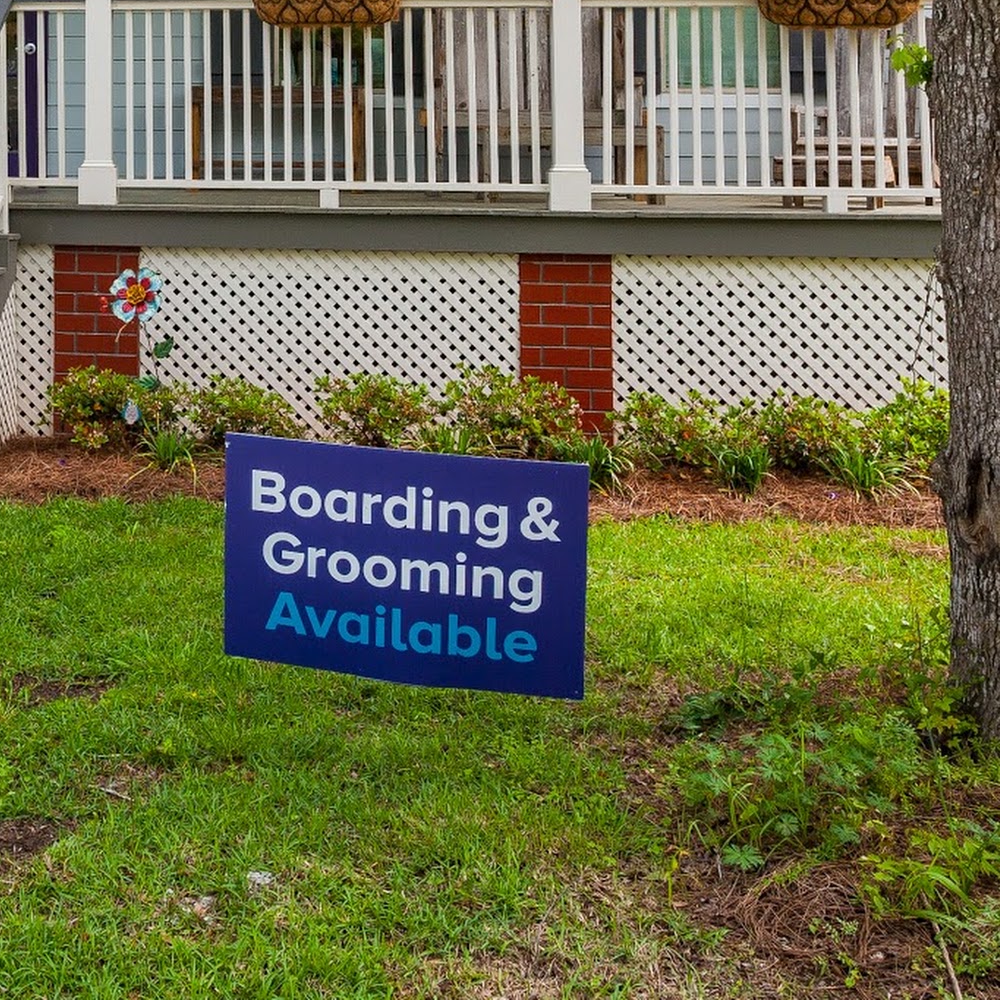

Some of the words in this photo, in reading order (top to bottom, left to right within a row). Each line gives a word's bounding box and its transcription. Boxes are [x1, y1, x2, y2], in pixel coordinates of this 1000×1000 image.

[251, 468, 509, 549] Boarding
[519, 496, 562, 543] &
[262, 531, 544, 614] Grooming
[265, 591, 538, 663] Available
